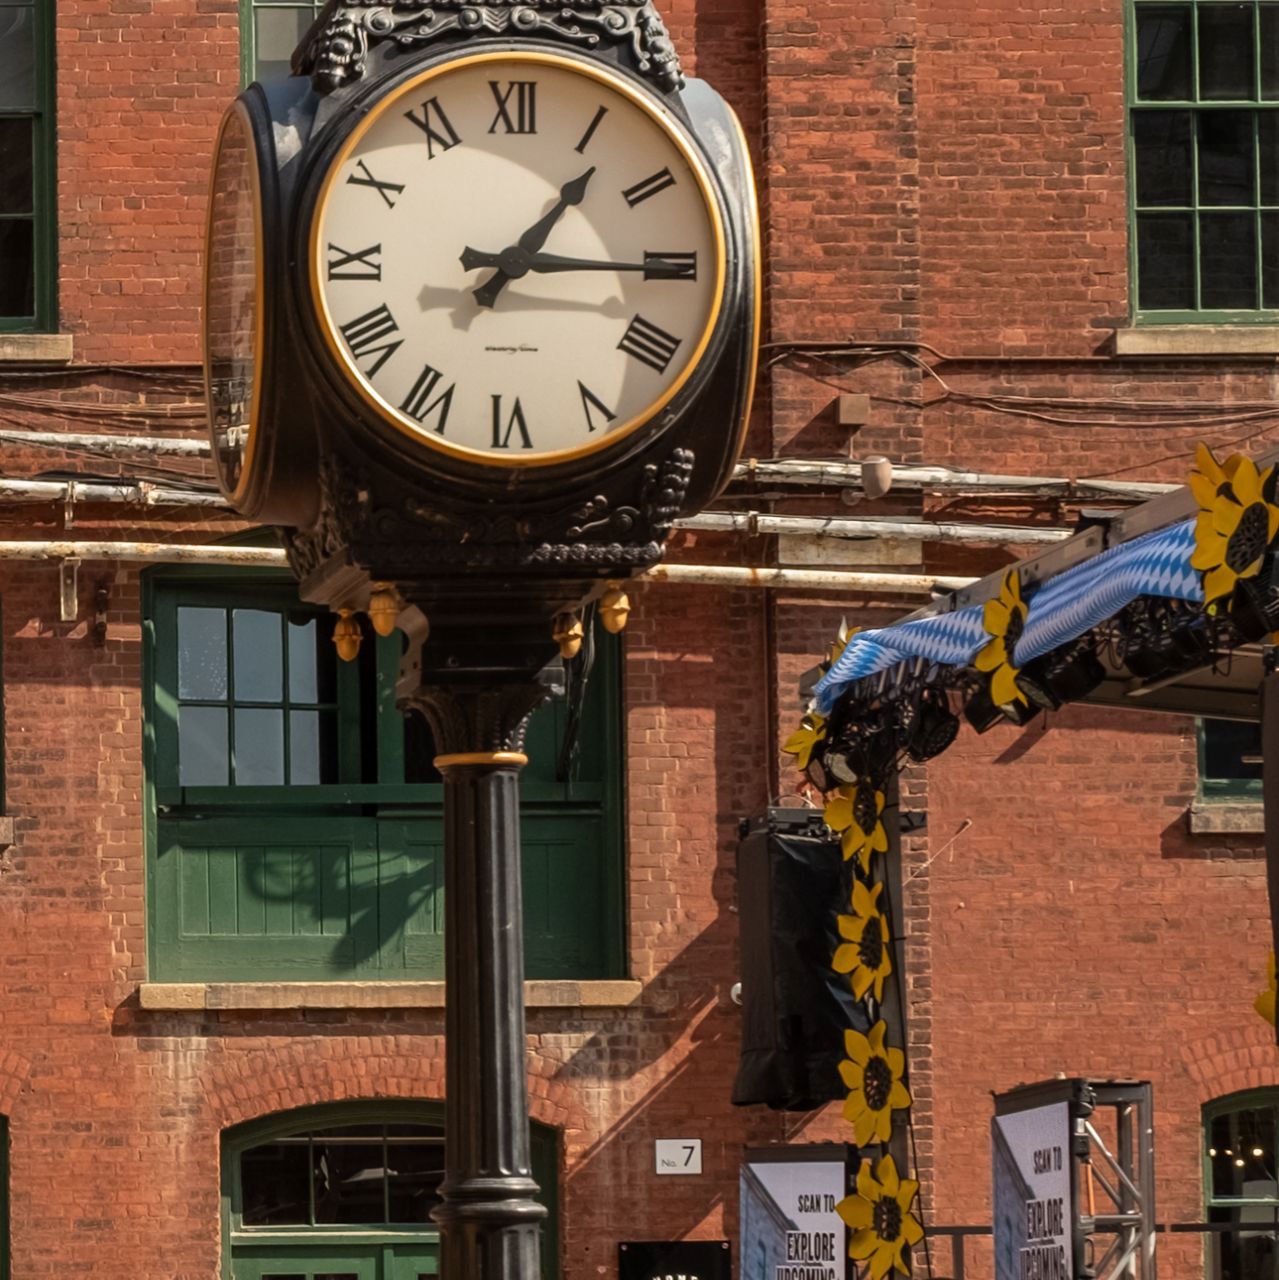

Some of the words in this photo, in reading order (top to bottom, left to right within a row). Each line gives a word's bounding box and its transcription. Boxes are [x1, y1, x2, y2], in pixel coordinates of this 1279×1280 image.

[403, 96, 463, 160] XI
[487, 81, 537, 134] XII
[347, 160, 405, 208] X
[622, 167, 677, 208] II
[328, 242, 382, 282] IX
[338, 303, 405, 380] VIII
[400, 365, 456, 435] VII
[490, 394, 533, 448] VI
[577, 380, 617, 432] V
[682, 1146, 695, 1167] 7
[1033, 1147, 1052, 1174] SCAN
[1053, 1146, 1062, 1171] TO
[798, 1194, 820, 1213] SCAN
[824, 1194, 835, 1213] TO
[1026, 1197, 1064, 1240] EXPLORE
[786, 1232, 836, 1262] EXPLORE
